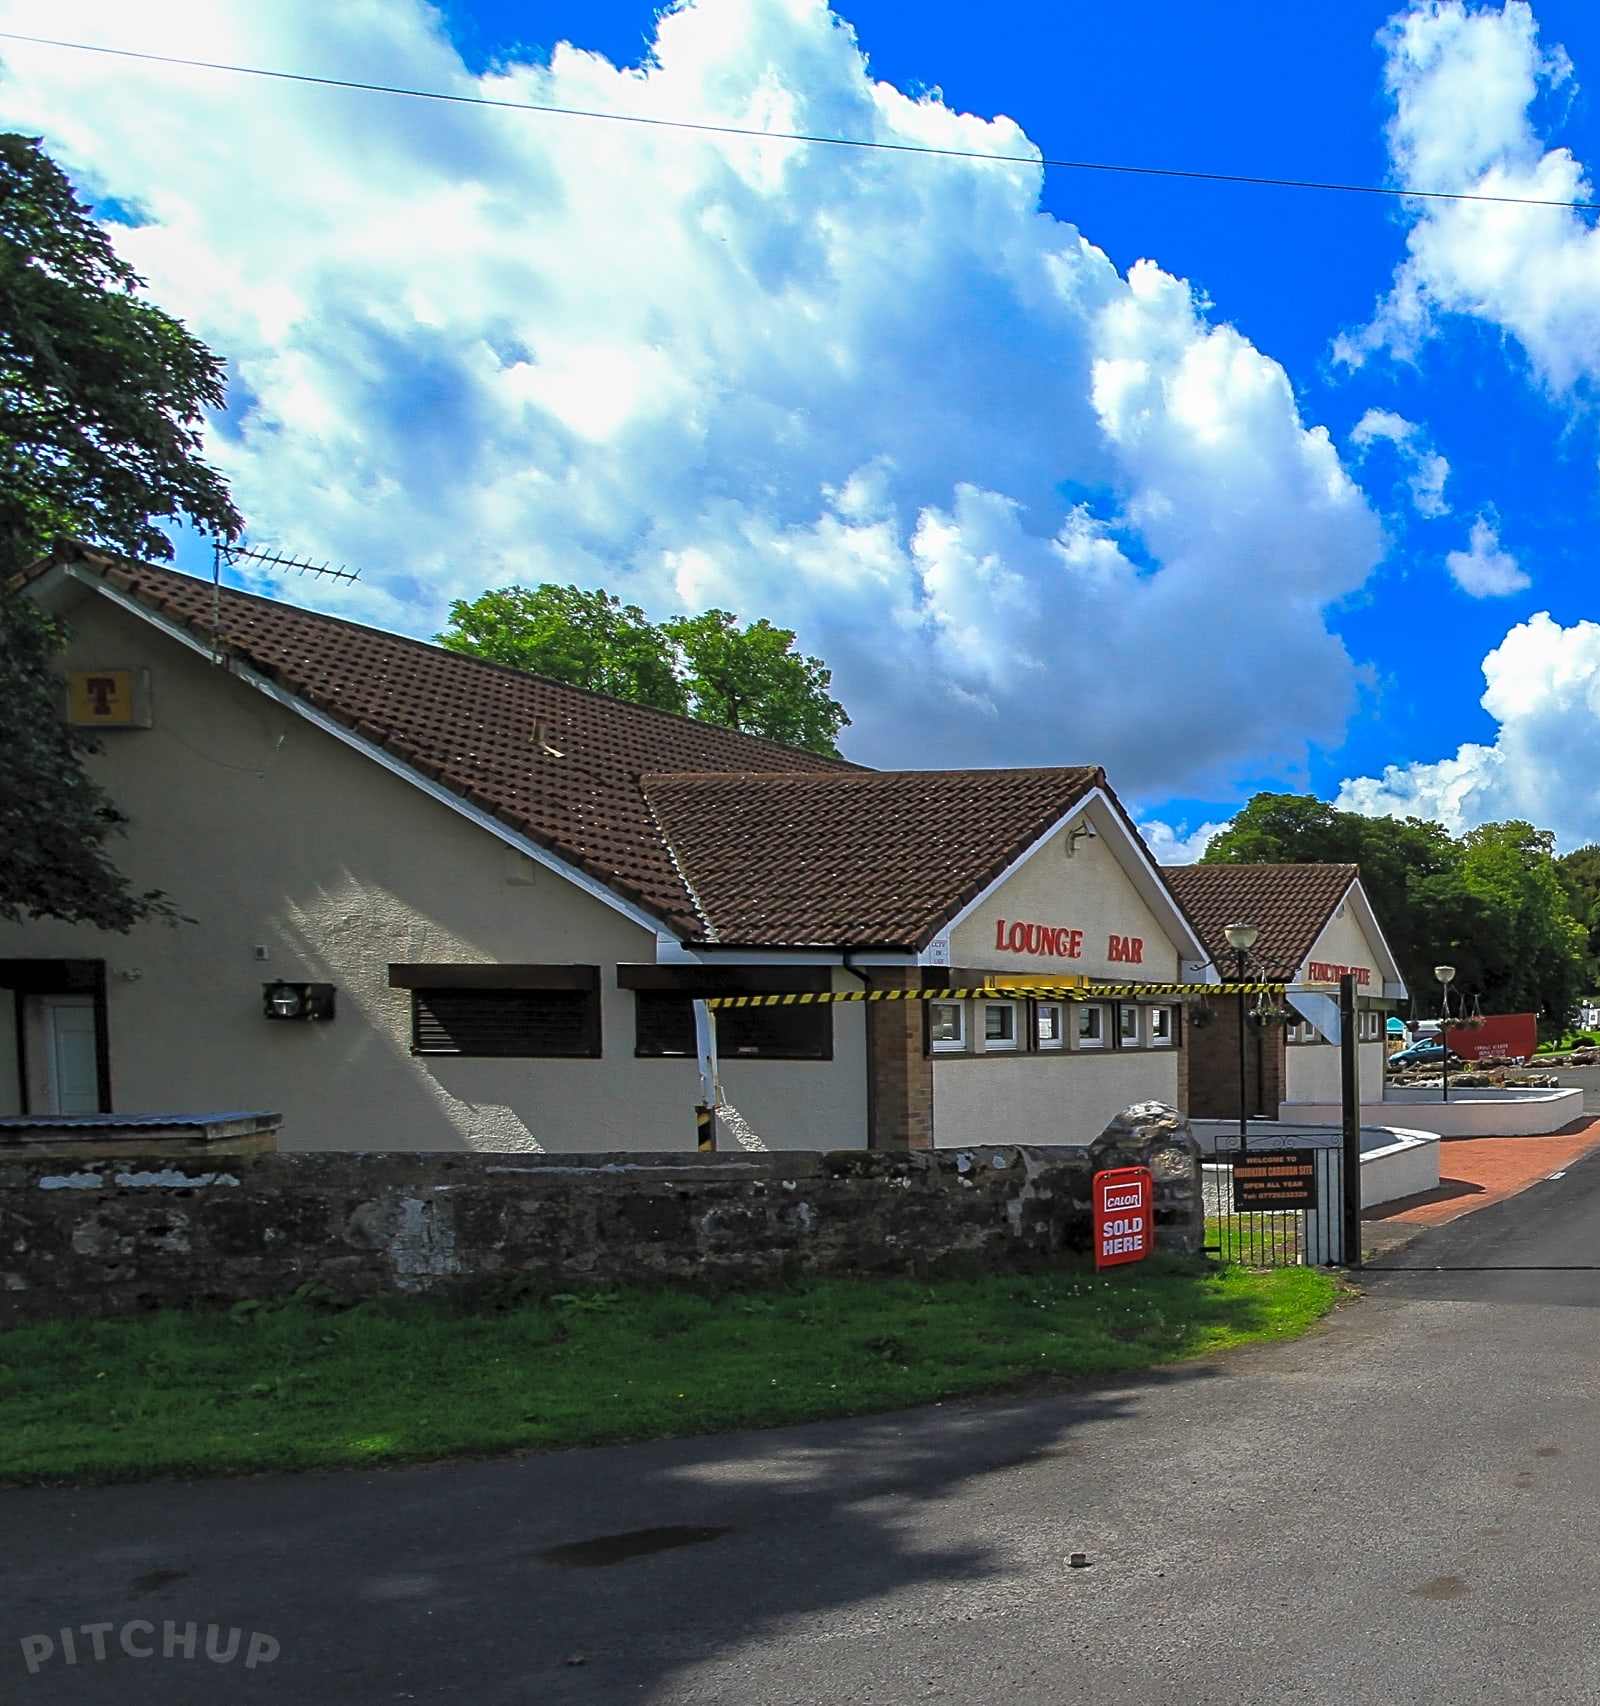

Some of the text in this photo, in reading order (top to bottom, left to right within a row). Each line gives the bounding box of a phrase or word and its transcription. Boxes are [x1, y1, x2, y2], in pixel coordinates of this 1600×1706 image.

[87, 678, 116, 715] T
[996, 919, 1144, 964] LOUNGE BAR
[1268, 1166, 1298, 1177] CARAVAN
[1298, 1165, 1313, 1175] SITE
[1107, 1194, 1139, 1207] CALOR
[1103, 1217, 1143, 1237] SOLD
[1103, 1235, 1143, 1256] HERE
